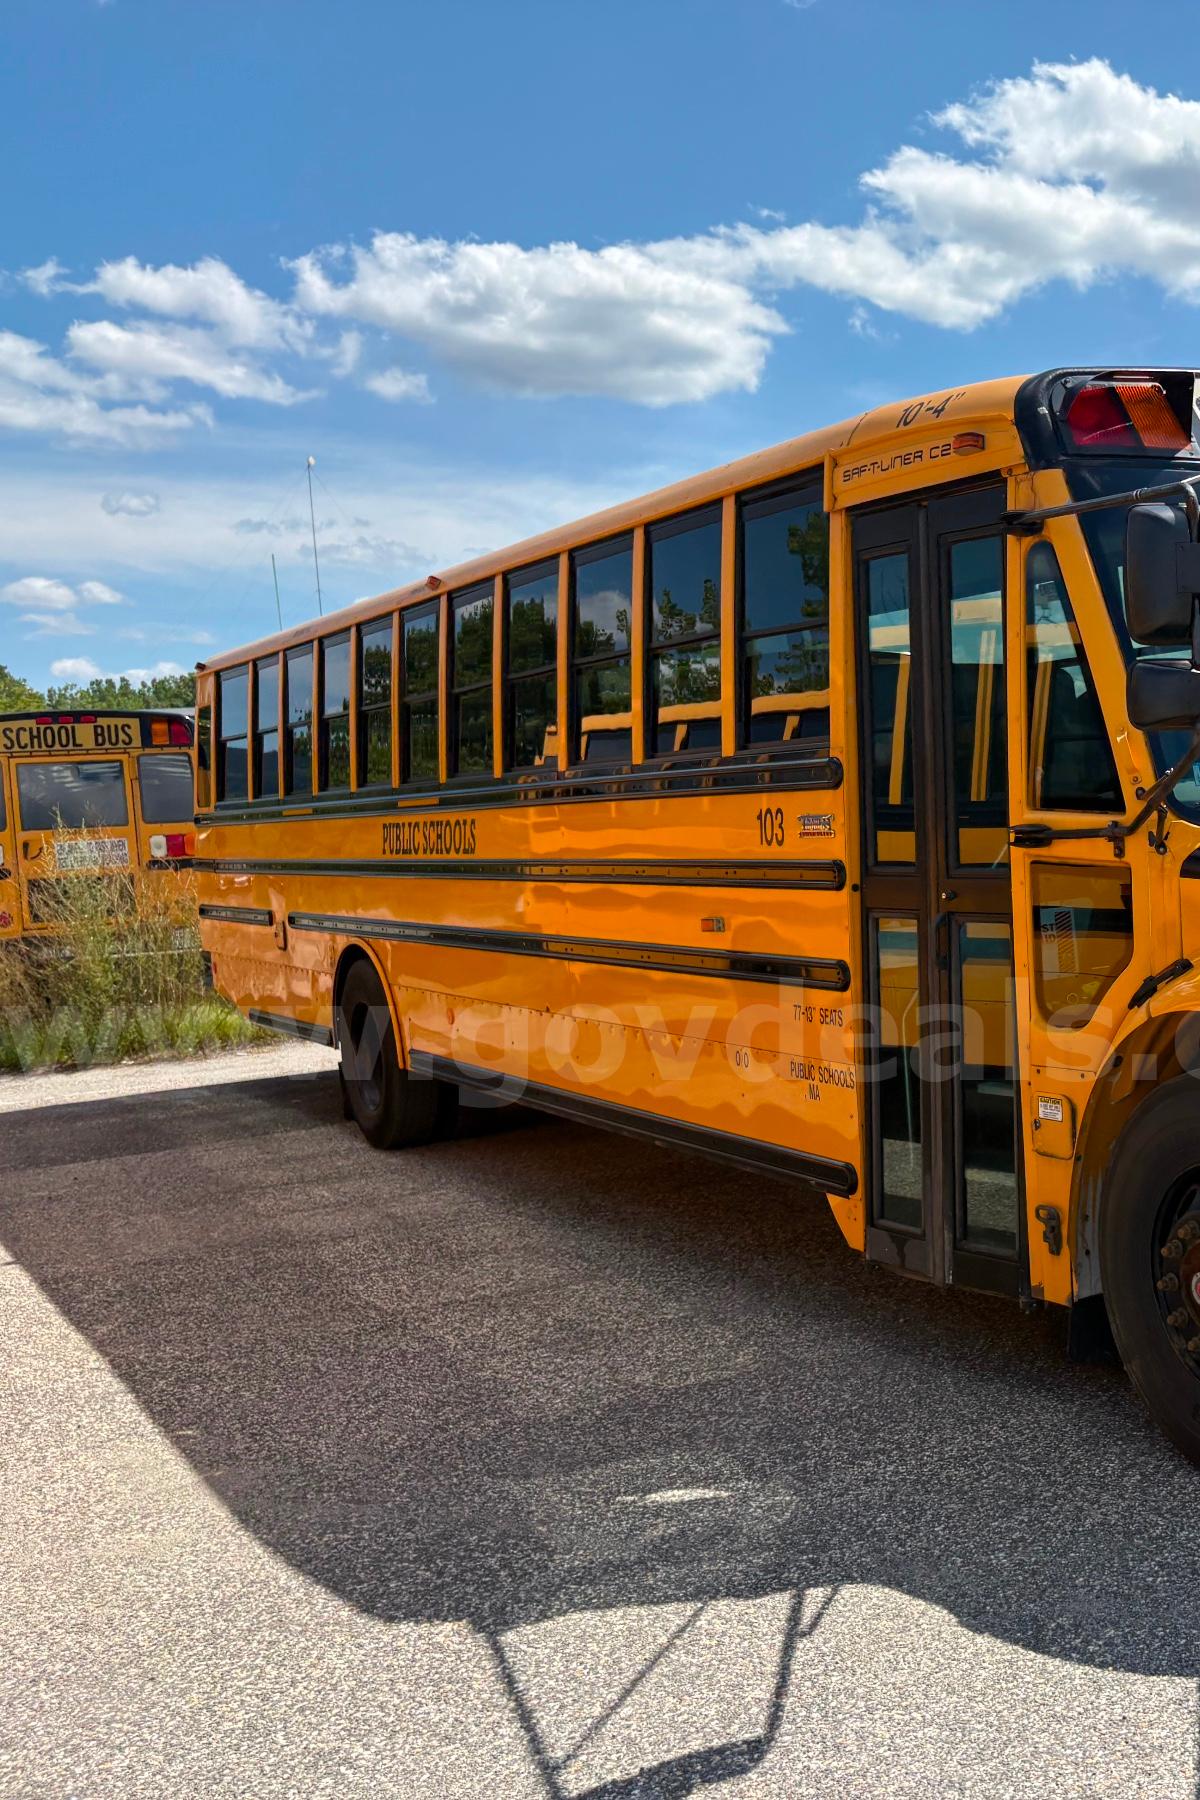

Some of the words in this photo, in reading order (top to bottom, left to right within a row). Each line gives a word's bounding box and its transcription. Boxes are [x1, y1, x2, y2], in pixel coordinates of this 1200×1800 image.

[843, 450, 923, 482] SAF-T-LINER
[929, 444, 952, 459] C2
[2, 725, 83, 750] SCHOOL
[94, 724, 133, 747] BUS
[383, 822, 420, 855] PUBLIC
[423, 819, 476, 854] SCHOOLS
[757, 807, 785, 847] 103
[820, 1007, 843, 1027] SEATS
[790, 1060, 815, 1081] PUBLIC
[818, 1065, 855, 1090] SCHOOLS
[808, 1083, 820, 1101] MA
